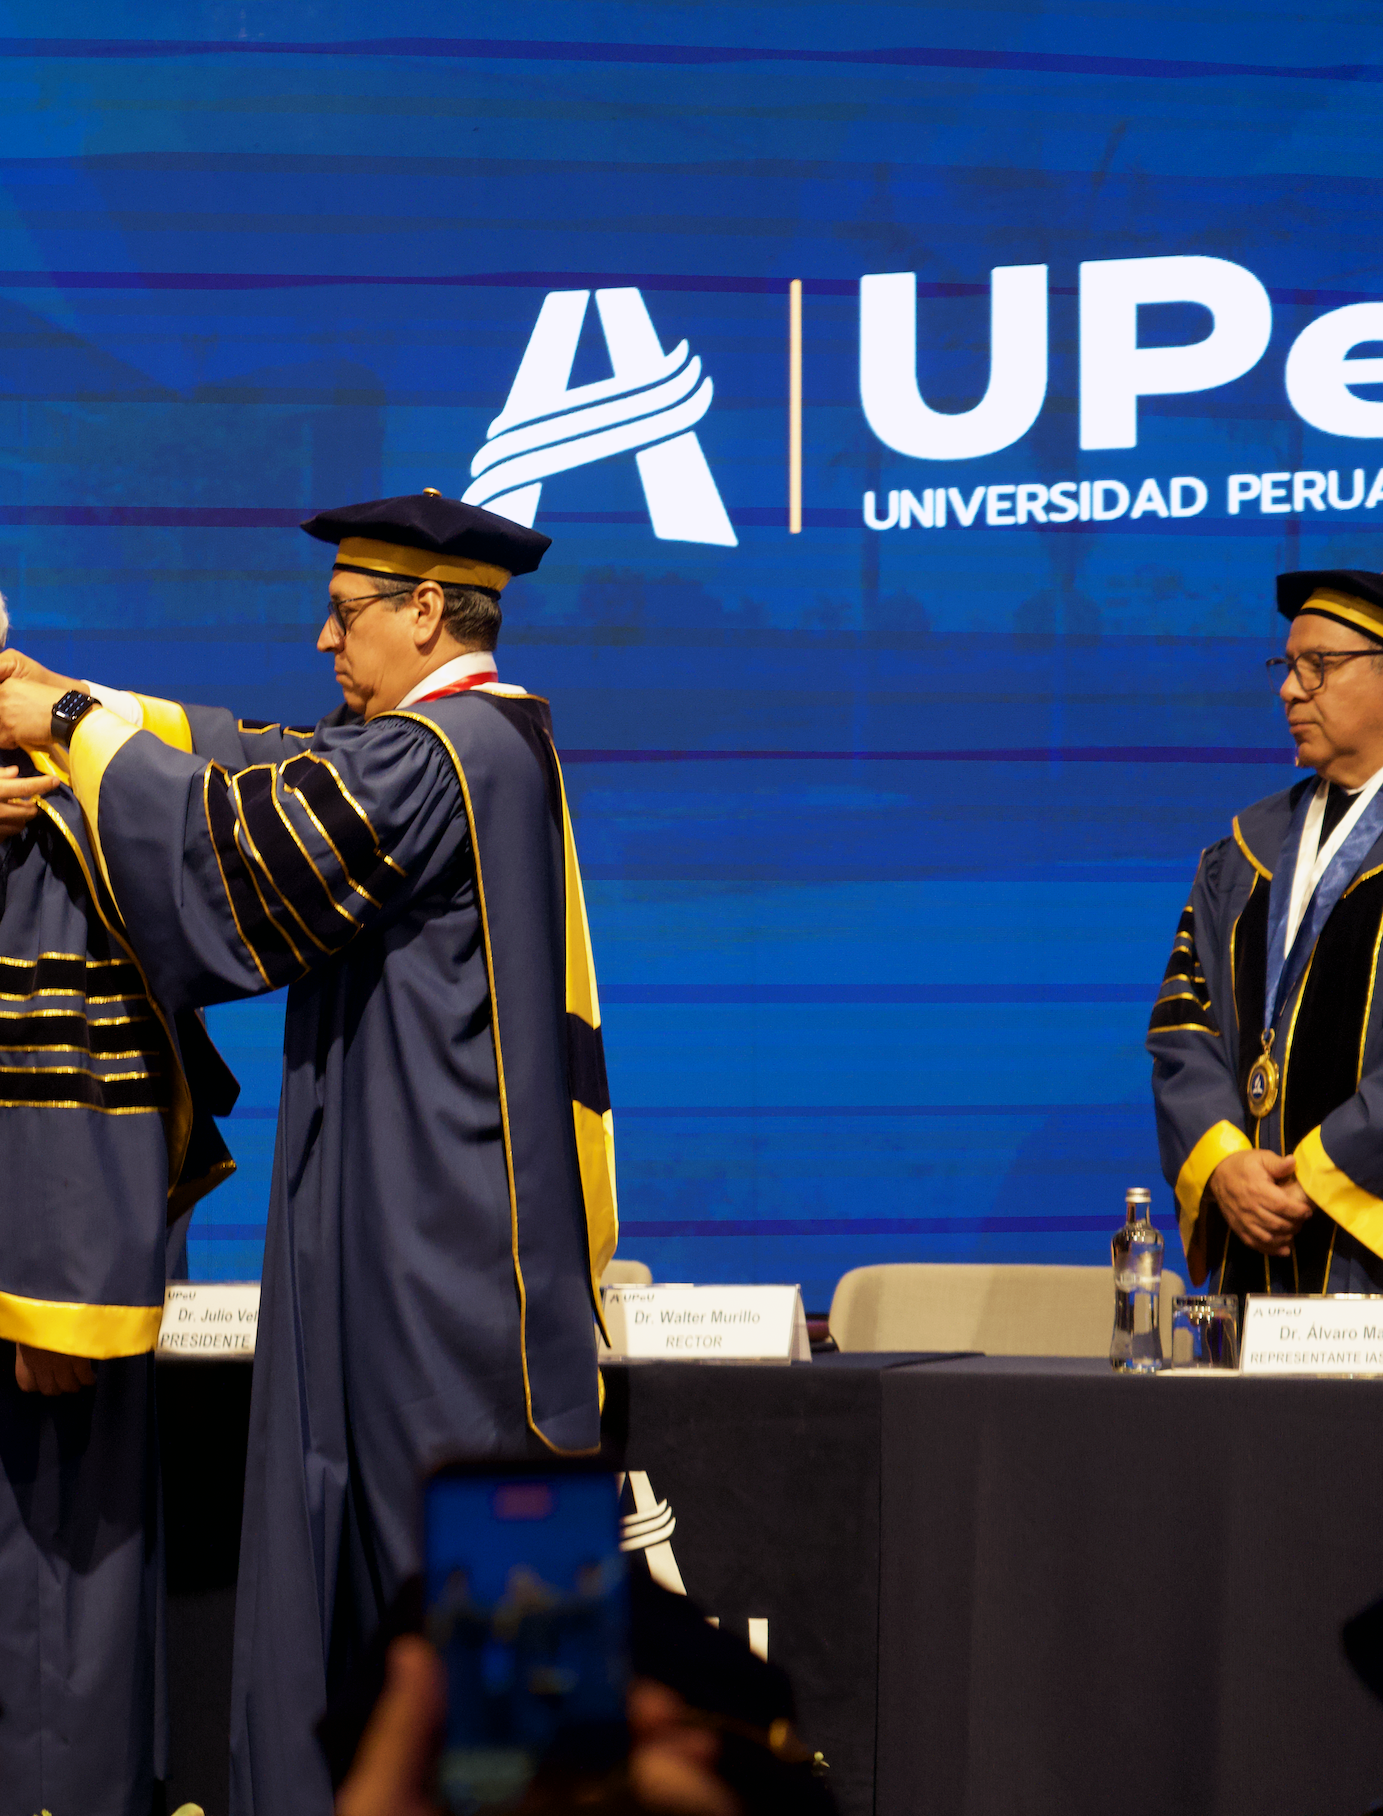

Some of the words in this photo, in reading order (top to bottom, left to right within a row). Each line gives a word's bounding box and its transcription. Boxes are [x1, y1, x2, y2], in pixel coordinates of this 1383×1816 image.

[859, 254, 1383, 461] UPe
[863, 475, 1209, 531] UNIVERSIDAD
[178, 1308, 197, 1323] Dr.
[200, 1308, 233, 1323] Julio
[634, 1310, 654, 1325] Dr.
[660, 1310, 707, 1325] Walter
[710, 1310, 761, 1325] Murillo
[1279, 1325, 1301, 1341] Dr.
[1306, 1321, 1358, 1341] Álvaro
[160, 1332, 251, 1350] PRESIDENTE
[665, 1334, 723, 1350] RECTOR
[1250, 1351, 1361, 1366] REPRESENTANTE
